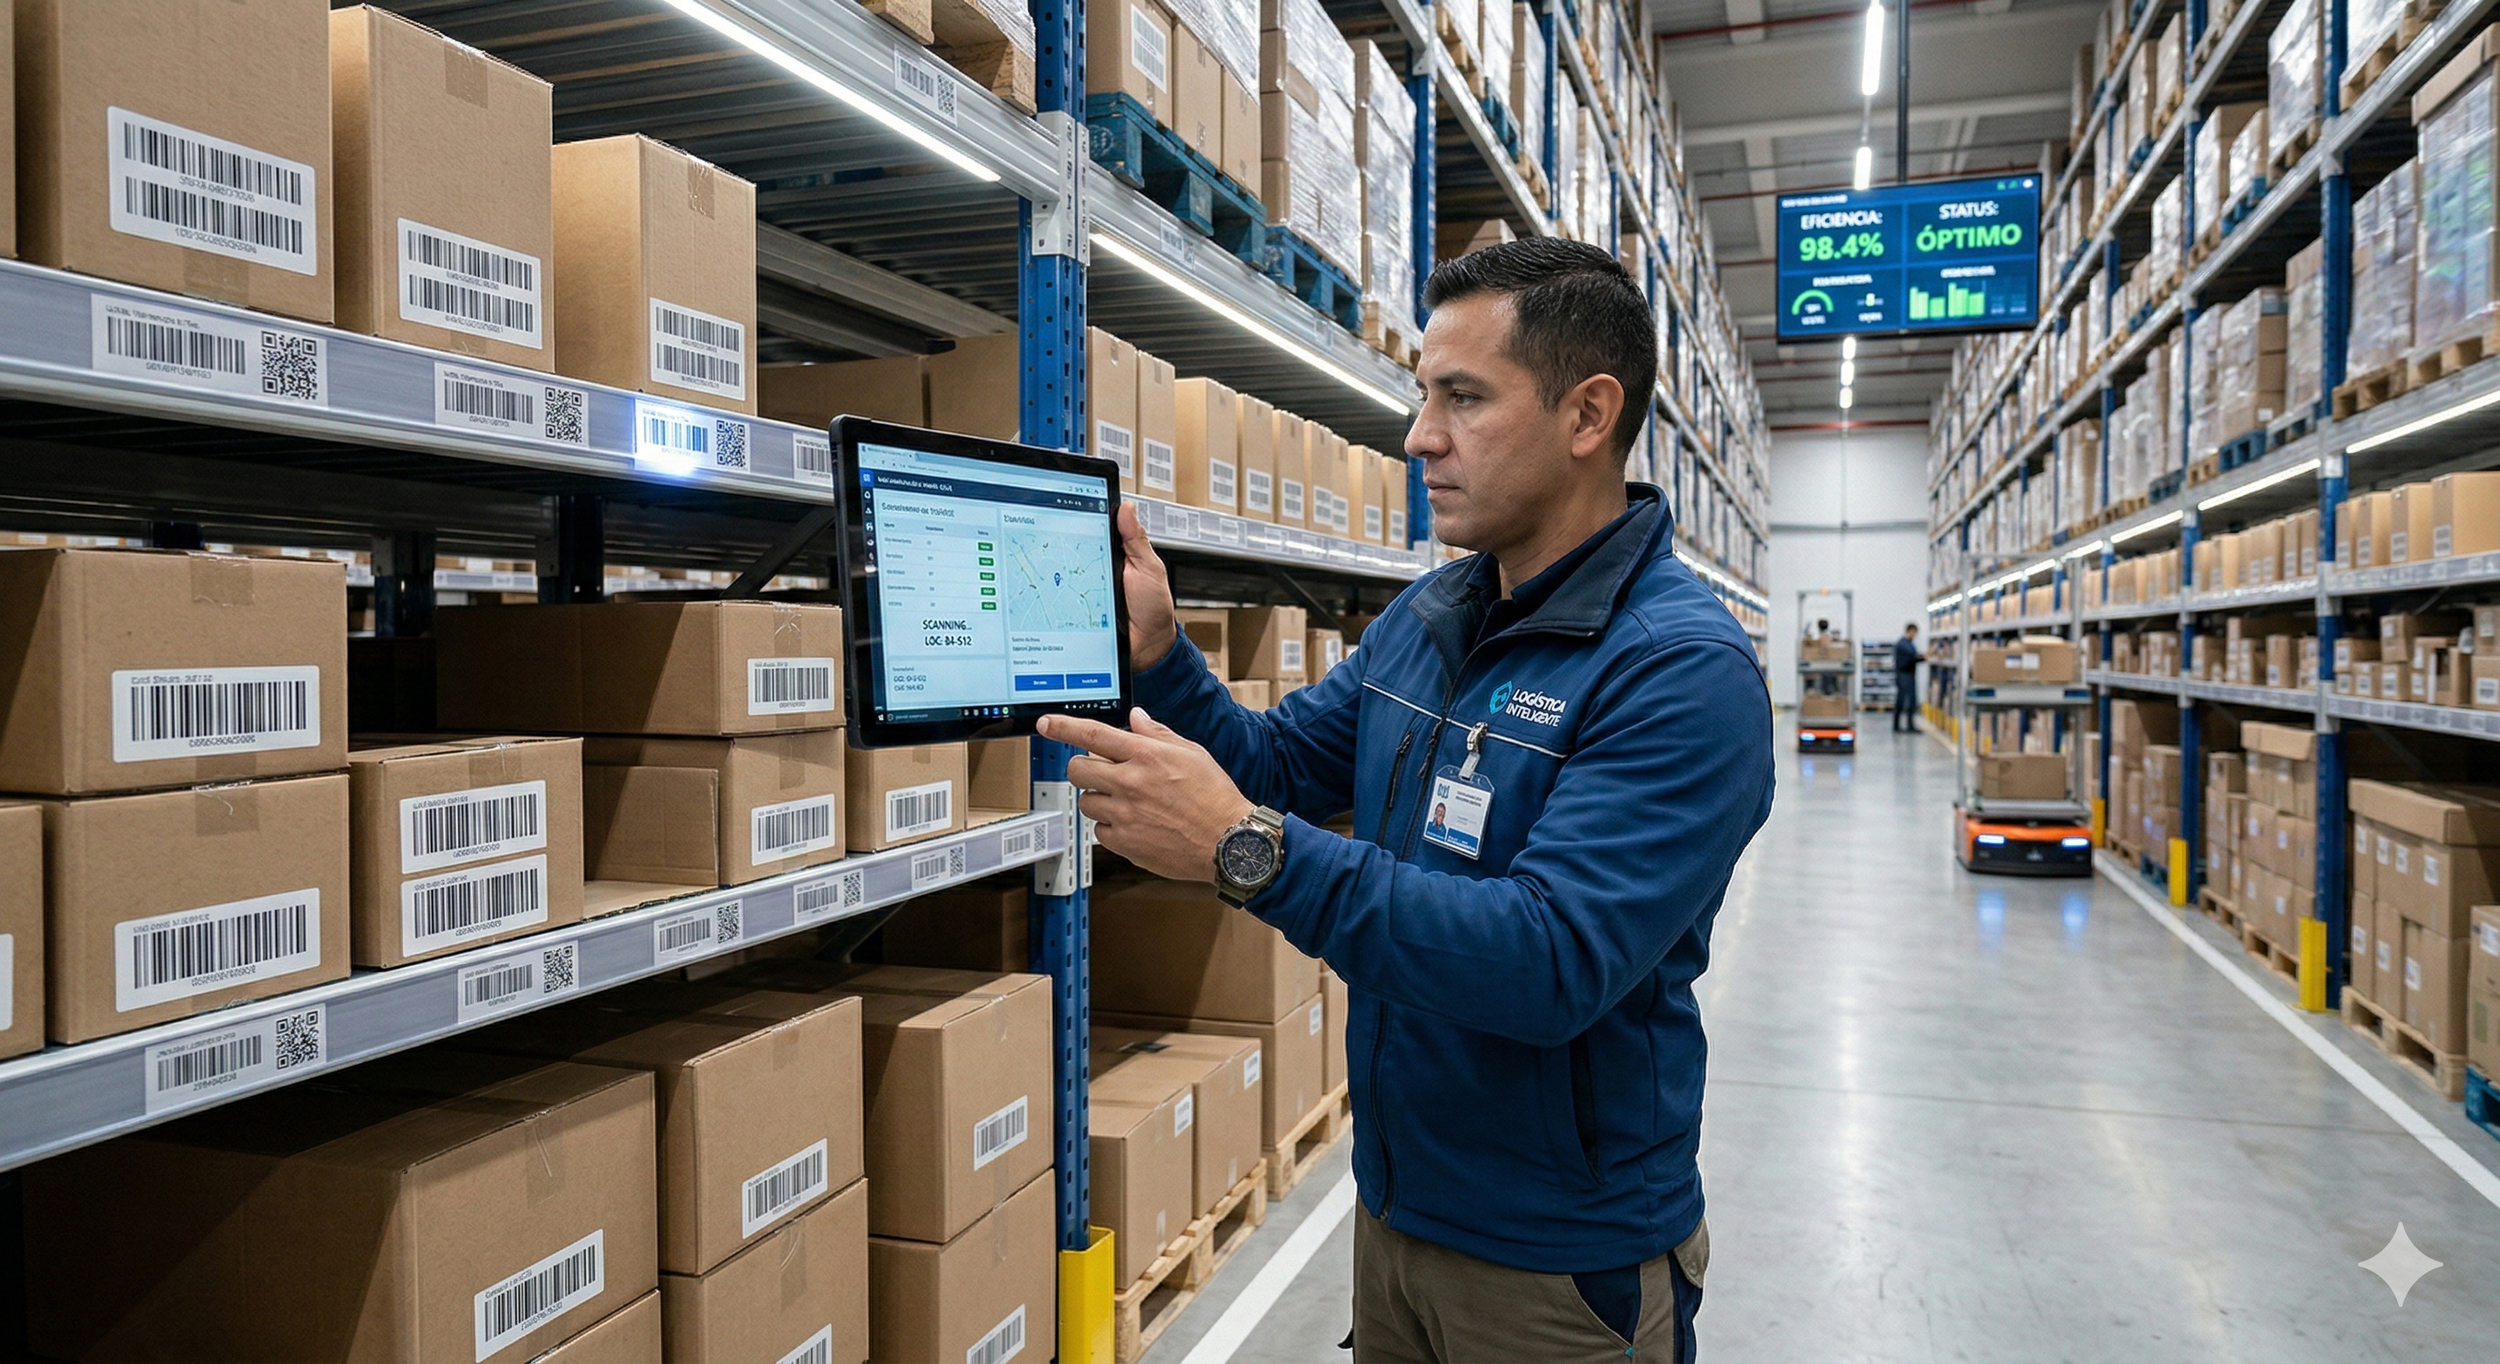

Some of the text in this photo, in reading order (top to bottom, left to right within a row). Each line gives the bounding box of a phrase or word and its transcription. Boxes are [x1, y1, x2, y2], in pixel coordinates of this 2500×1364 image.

[1800, 210, 1883, 230] EFICIENCIA:
[1939, 200, 1999, 220] STATUS:
[1800, 232, 1884, 262] 98.4%
[1916, 223, 2022, 252] ÓPTIMO
[1512, 689, 1567, 713] LOGÍSTICA
